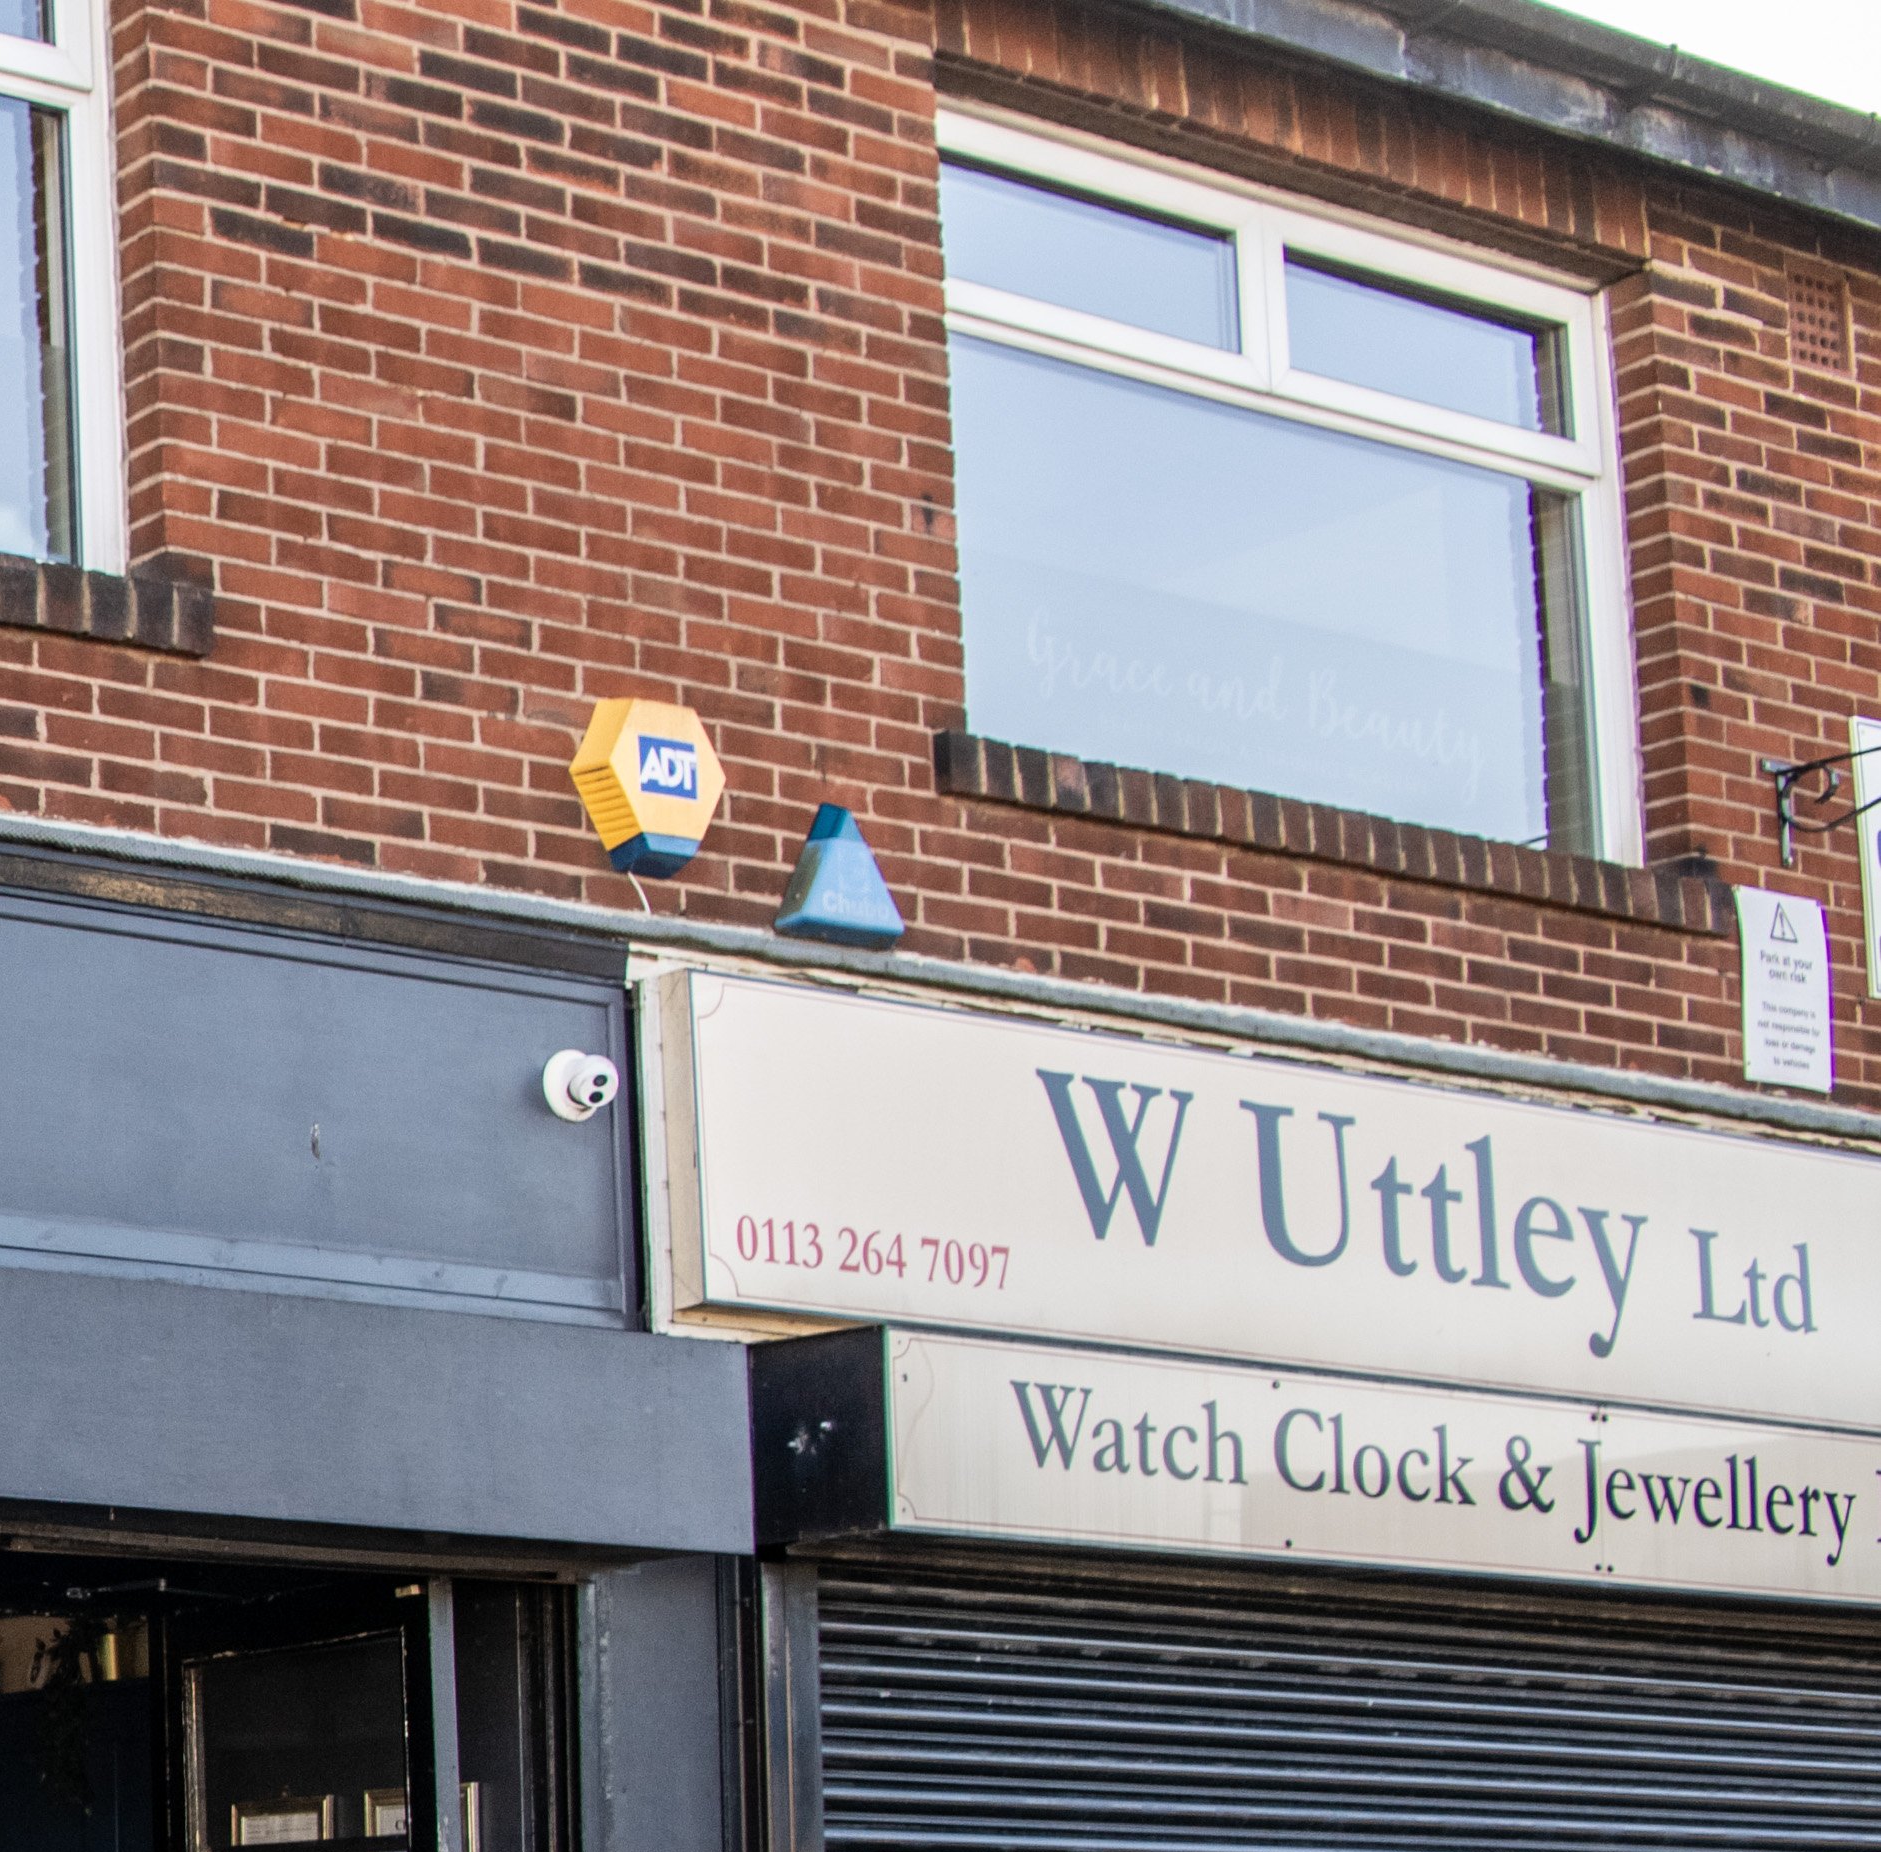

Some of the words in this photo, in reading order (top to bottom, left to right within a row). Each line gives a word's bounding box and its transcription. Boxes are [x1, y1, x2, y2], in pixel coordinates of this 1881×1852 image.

[641, 747, 696, 790] ADT
[1760, 950, 1780, 964] Park
[1794, 960, 1812, 972] your
[1037, 1066, 1194, 1249] W
[1237, 1097, 1648, 1359] Uttley
[1690, 1226, 1819, 1337] Ltd
[734, 1213, 823, 1270] 0113
[838, 1226, 907, 1281] 264
[918, 1236, 1011, 1291] 7097
[1009, 1378, 1249, 1488] Watch
[1272, 1405, 1476, 1510] Clock
[1497, 1434, 1554, 1515] &
[1573, 1436, 1856, 1566] Jewellery
